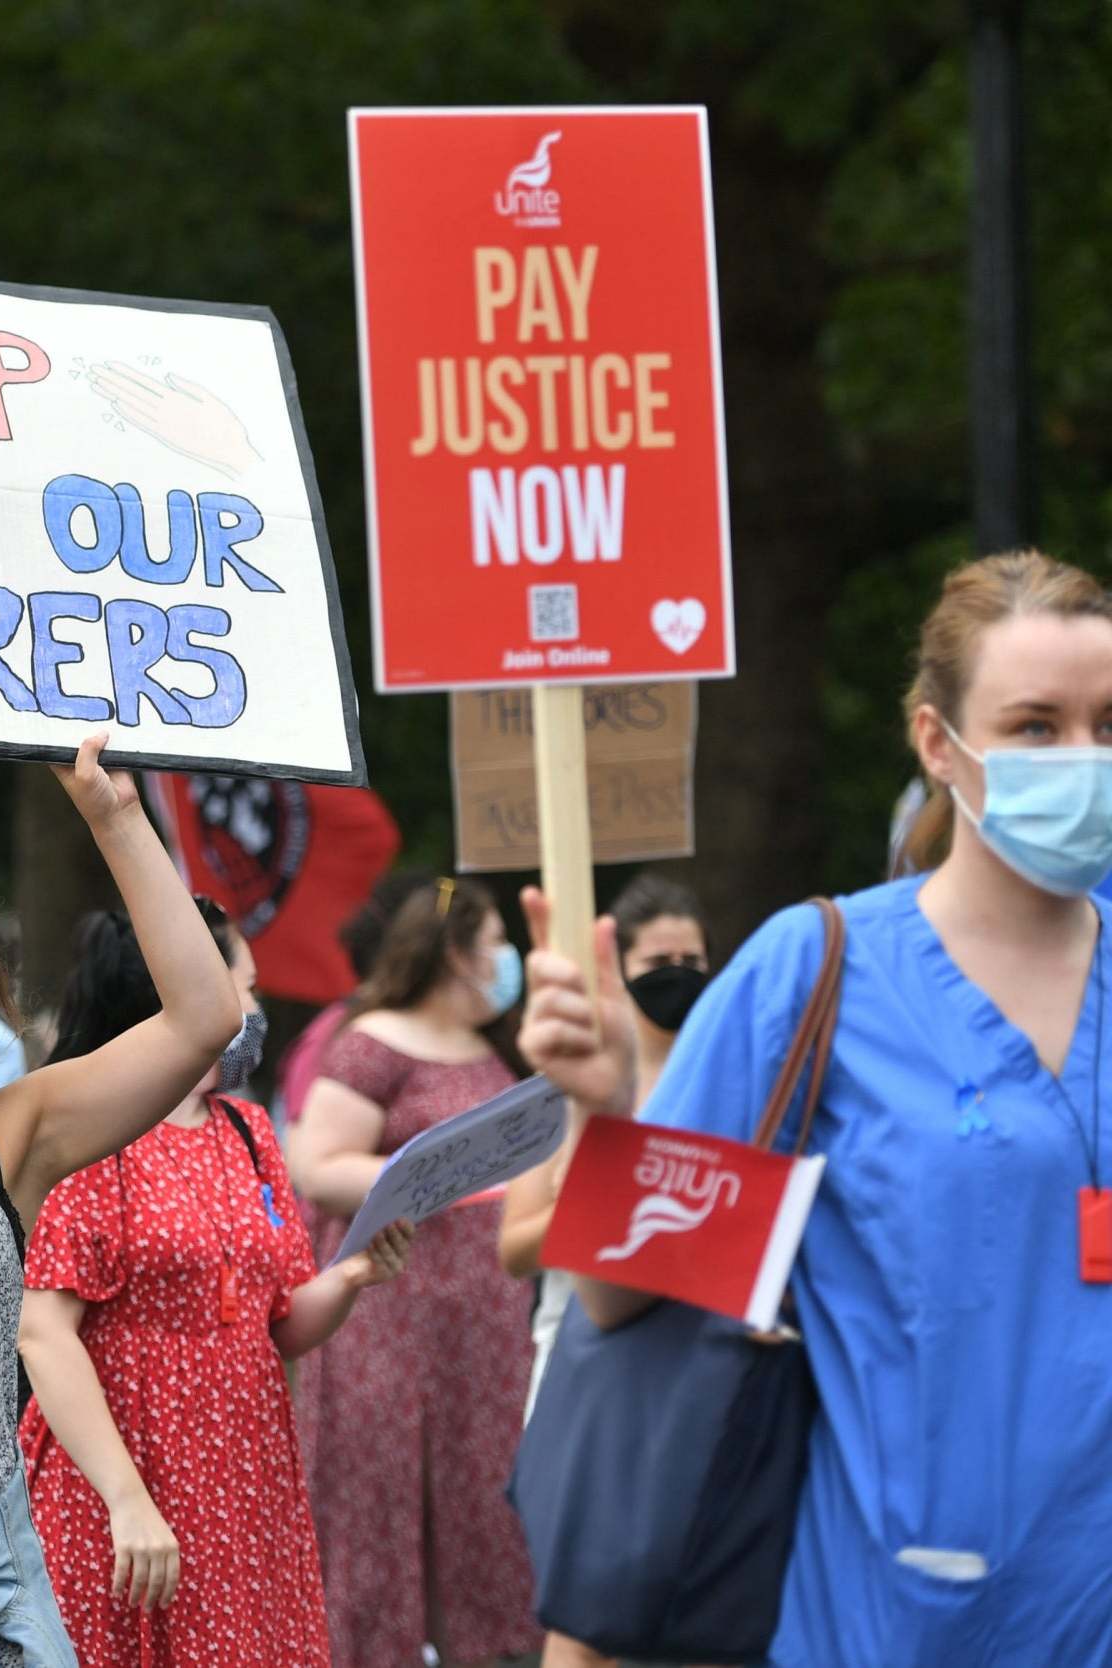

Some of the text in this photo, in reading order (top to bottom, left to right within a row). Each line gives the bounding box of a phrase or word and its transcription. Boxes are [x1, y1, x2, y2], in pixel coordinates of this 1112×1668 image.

[493, 186, 561, 216] unite
[474, 245, 598, 343] PAY
[411, 353, 675, 457] JUSTICE
[43, 473, 286, 594] OUR
[468, 464, 626, 567] NOW
[501, 646, 610, 670] Join Online
[633, 1153, 742, 1208] unite
